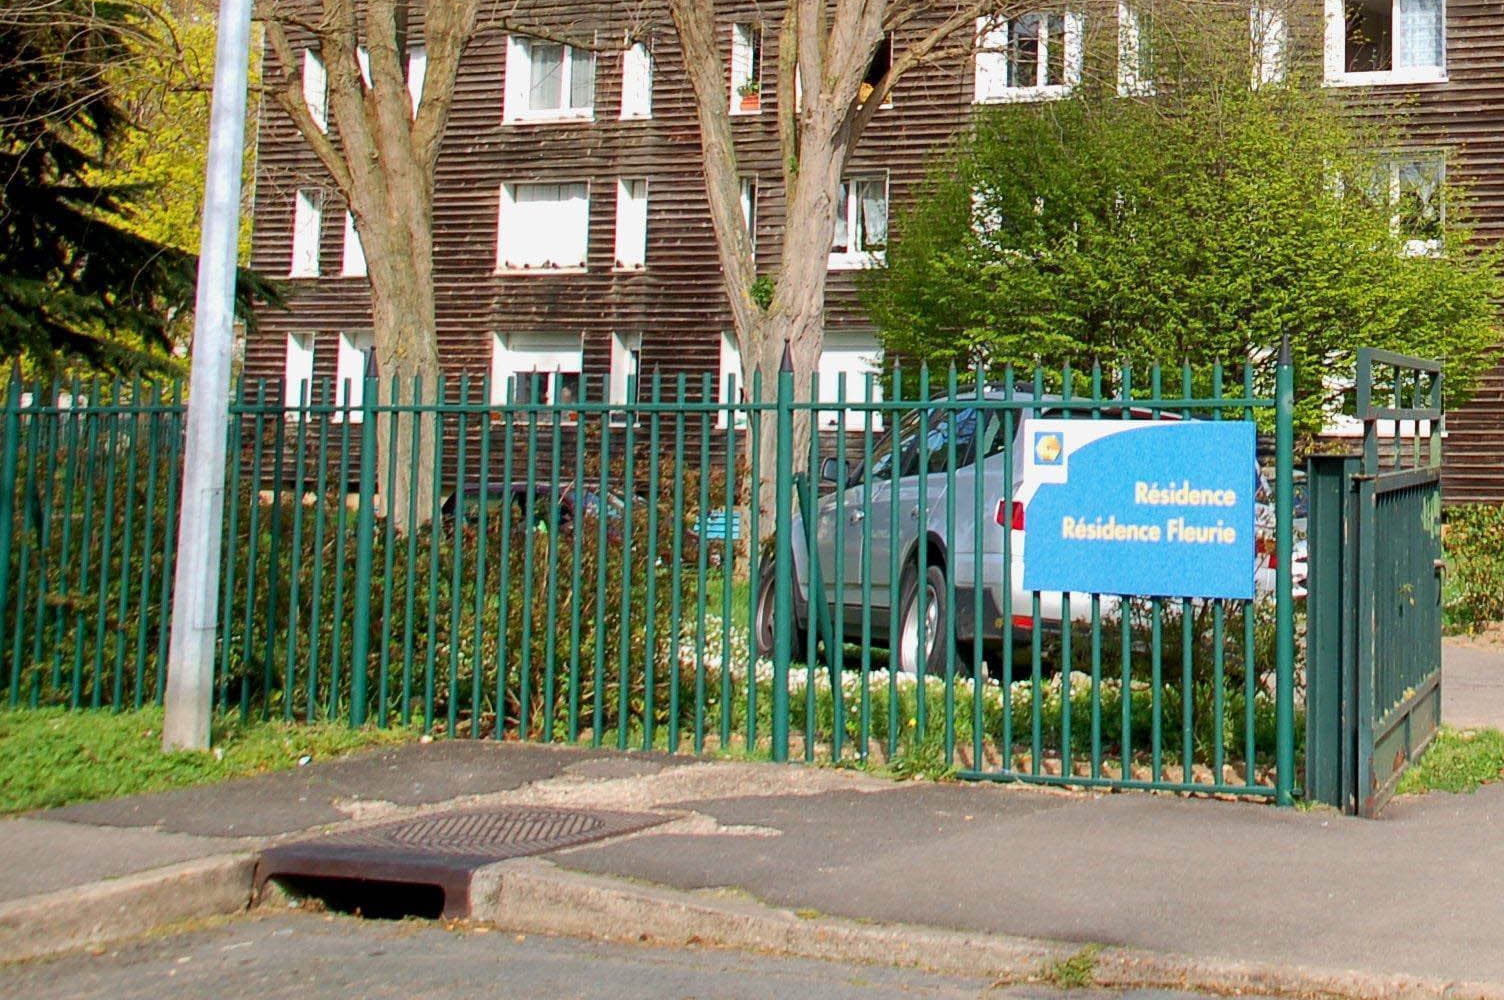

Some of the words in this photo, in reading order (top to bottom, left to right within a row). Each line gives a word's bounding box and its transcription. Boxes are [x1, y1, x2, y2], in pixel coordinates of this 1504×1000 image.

[1134, 480, 1237, 506] Résidence
[1062, 515, 1161, 542] Résidence
[1166, 517, 1236, 544] Fleurie
